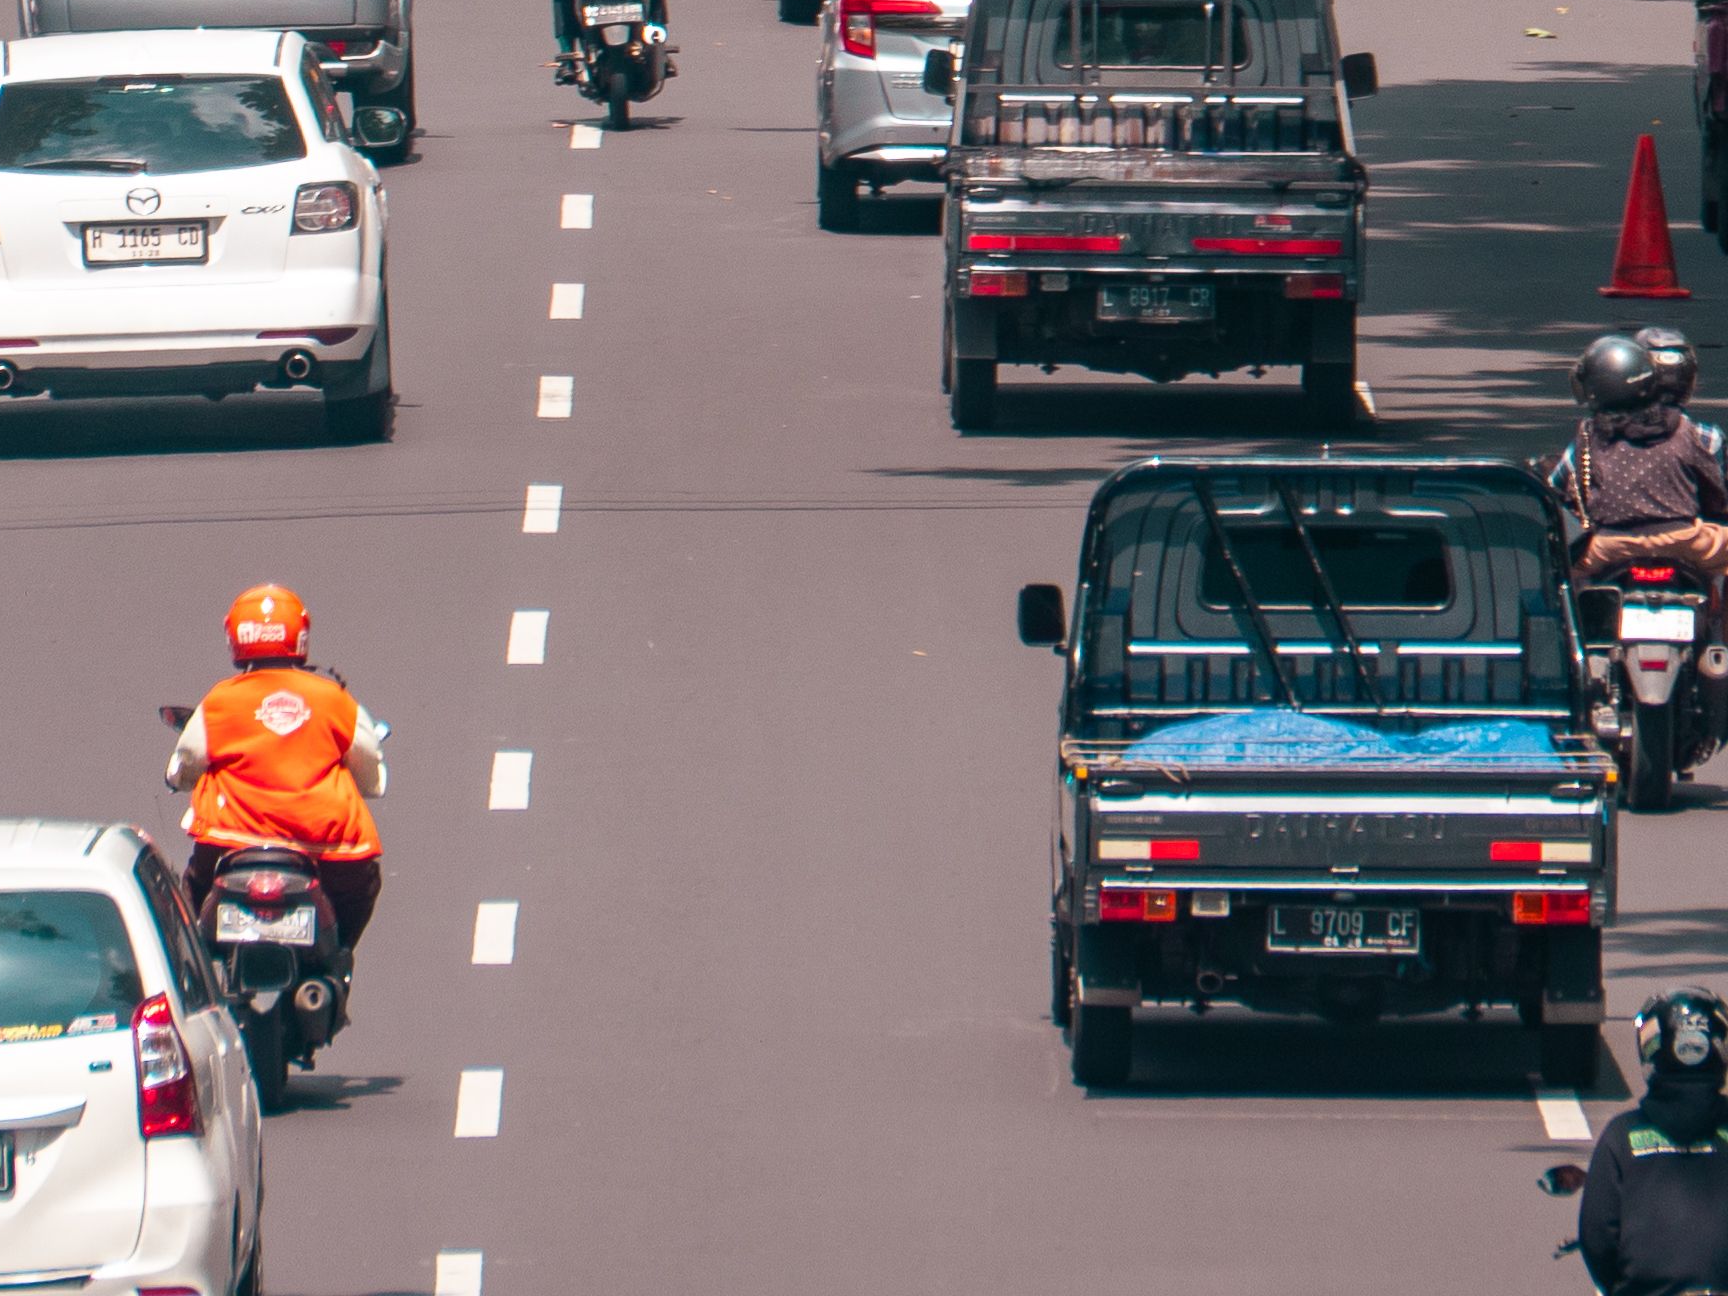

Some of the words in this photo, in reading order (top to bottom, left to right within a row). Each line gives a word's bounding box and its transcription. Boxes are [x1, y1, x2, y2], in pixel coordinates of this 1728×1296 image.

[118, 226, 162, 249] 1165
[177, 225, 199, 246] CD
[1102, 287, 1114, 307] L
[1129, 287, 1169, 306] 8917
[1273, 909, 1286, 935] L
[1311, 910, 1364, 936] 9709
[1387, 911, 1413, 936] CF
